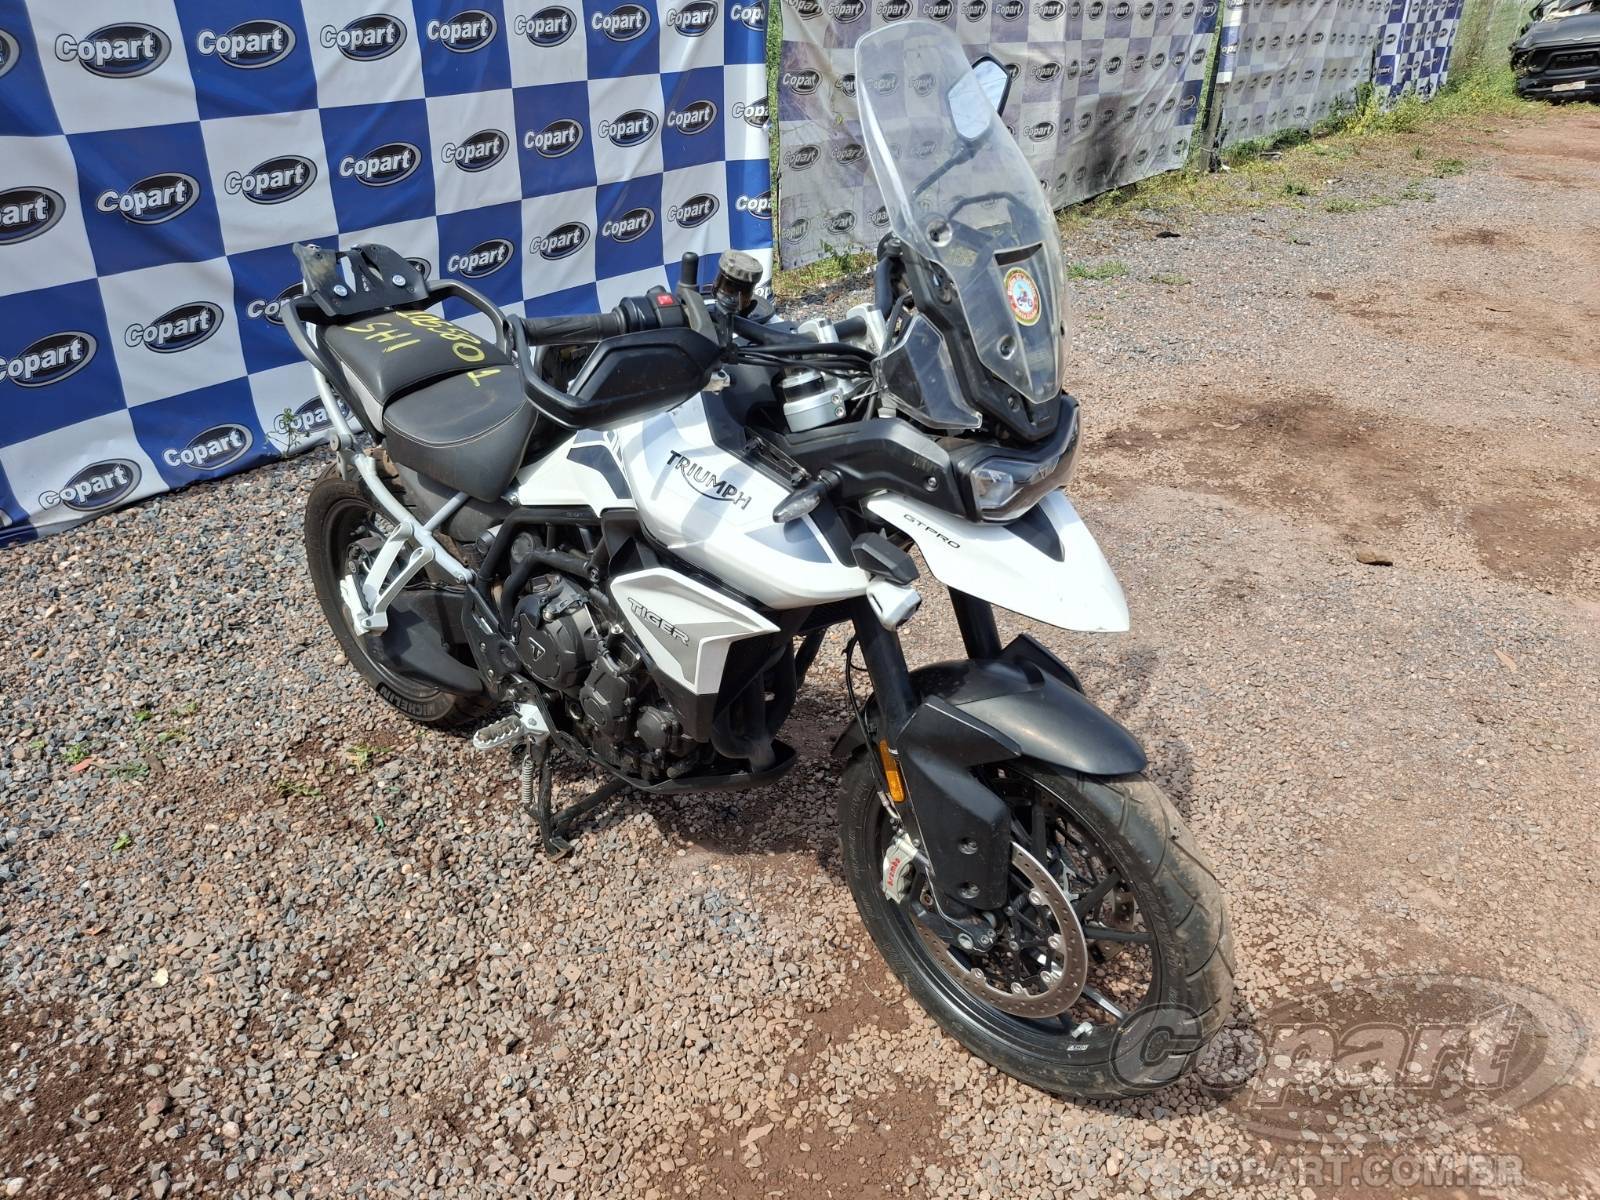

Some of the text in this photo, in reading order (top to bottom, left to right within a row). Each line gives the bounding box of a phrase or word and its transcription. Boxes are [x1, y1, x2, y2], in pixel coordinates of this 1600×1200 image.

[427, 18, 489, 43] Copart
[514, 13, 569, 38] Copart
[592, 12, 643, 33] Copart
[666, 8, 714, 30] Copart
[55, 33, 155, 65] Copart
[198, 27, 284, 58] Copart
[320, 22, 395, 49] Copart
[599, 115, 649, 139] Copart
[667, 107, 711, 128] Copart
[441, 135, 500, 163] Copart
[524, 127, 576, 152] Copart
[339, 148, 411, 181] Copart
[225, 163, 305, 195] Copart
[96, 180, 188, 215] Copart
[667, 199, 711, 222] Copart
[602, 214, 649, 237] Copart
[529, 227, 581, 254] Copart
[448, 243, 506, 273] Copart
[124, 307, 210, 347] Copart
[163, 430, 244, 467] Copart
[39, 466, 129, 510] Copart
[666, 449, 752, 510] TRIUMPH
[627, 597, 689, 647] TIGER
